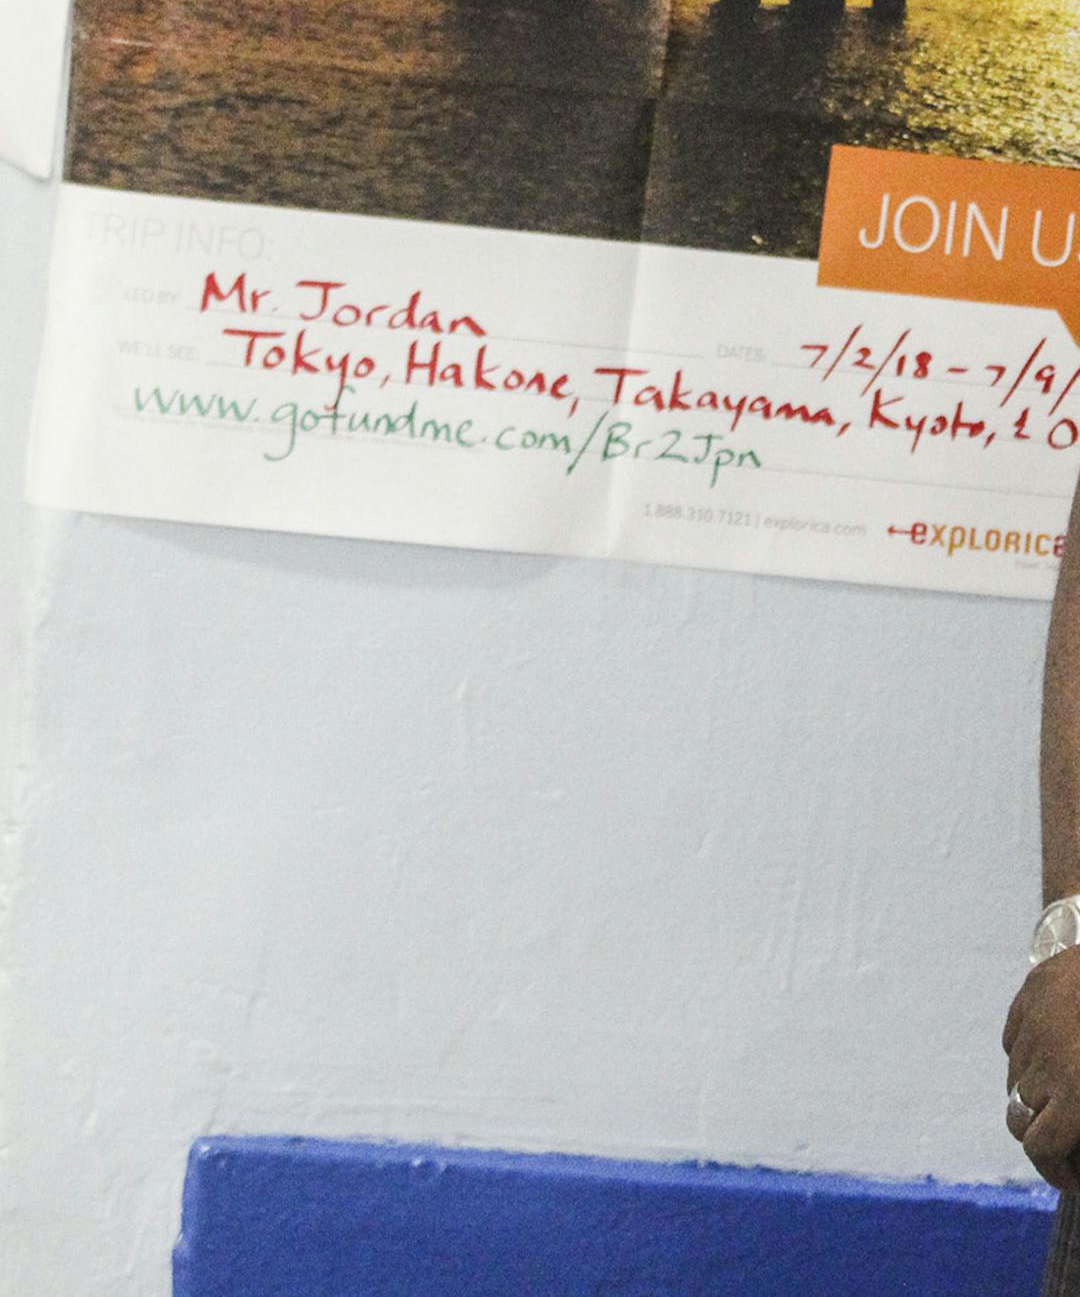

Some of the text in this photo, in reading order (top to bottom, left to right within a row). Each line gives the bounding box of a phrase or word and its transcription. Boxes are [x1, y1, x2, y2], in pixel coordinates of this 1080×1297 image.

[84, 210, 275, 263] TRIP INFO:
[858, 193, 1008, 262] JOIN
[199, 271, 487, 338] Mr. Jordan
[221, 327, 391, 412] Tokyo,
[405, 339, 580, 419] Hakone,
[593, 366, 851, 438] Takayama,
[868, 386, 997, 454] Kyoto,
[800, 323, 932, 397] 7/2/18
